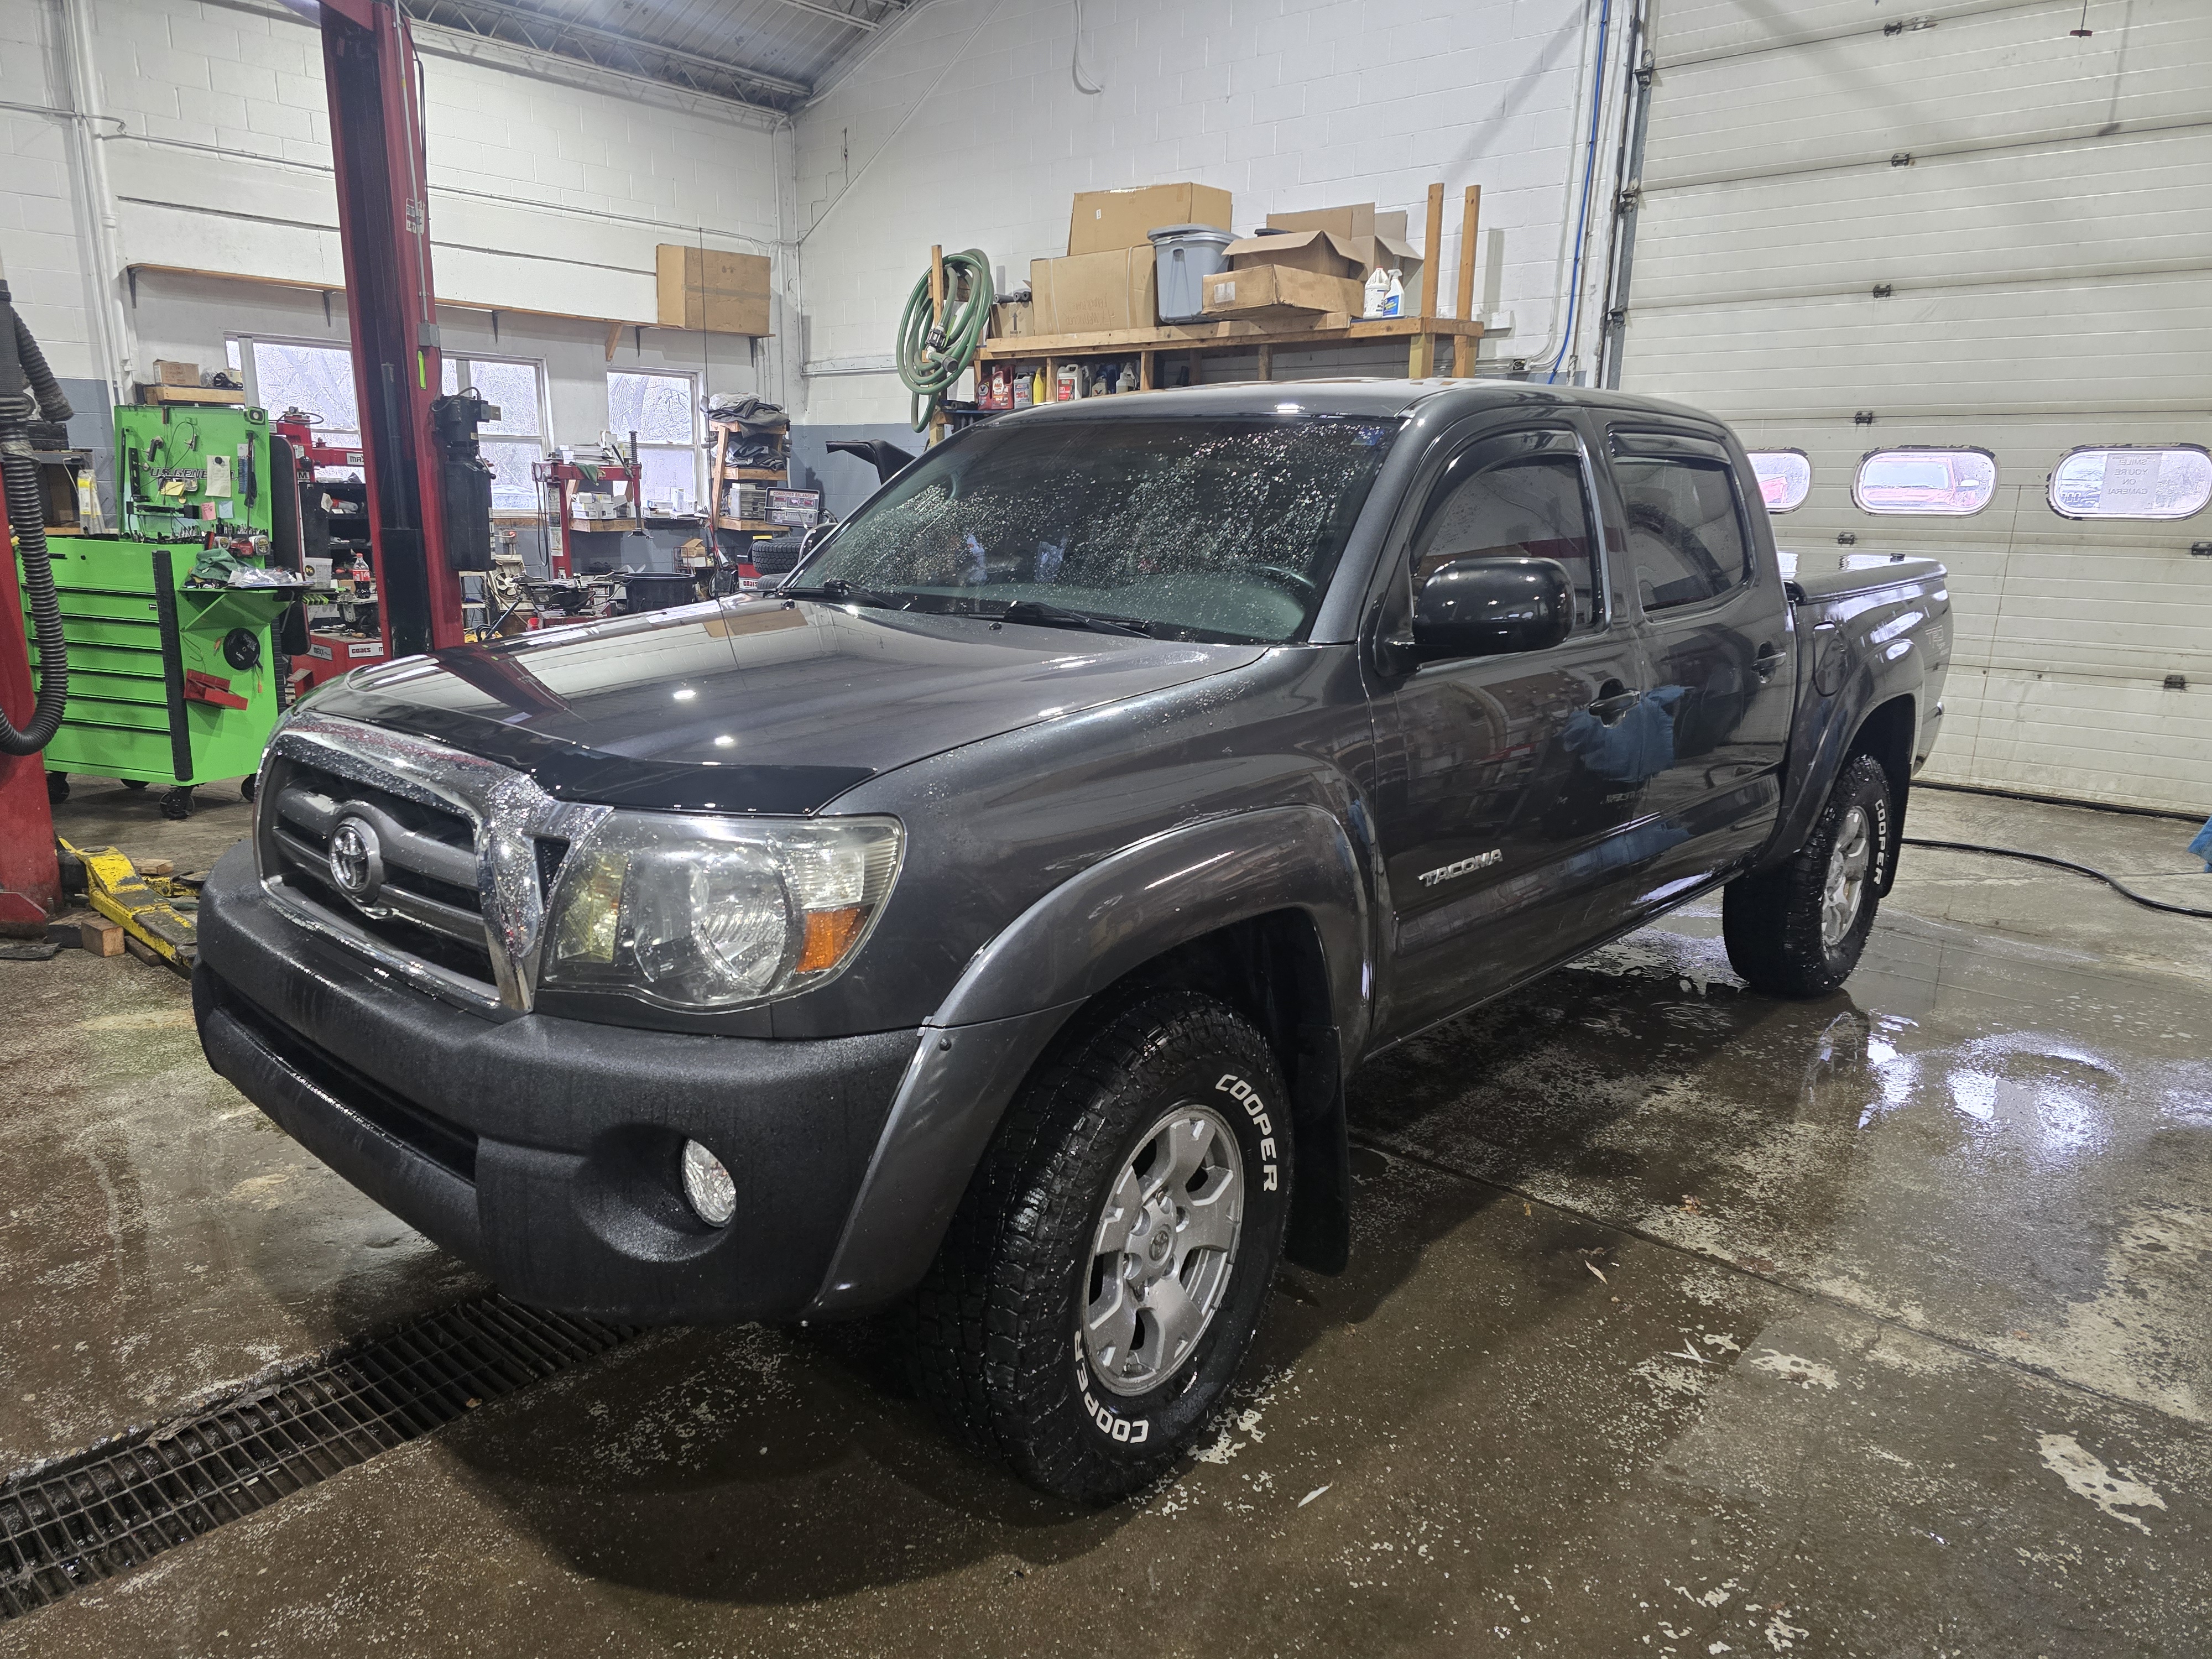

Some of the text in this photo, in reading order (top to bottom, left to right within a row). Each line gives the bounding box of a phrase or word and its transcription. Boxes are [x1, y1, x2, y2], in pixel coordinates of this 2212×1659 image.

[1417, 848, 1504, 887] TACOMA
[1874, 799, 1886, 884] COOPER
[1215, 1074, 1277, 1191] COOPER
[1074, 1329, 1149, 1443] COOPER
